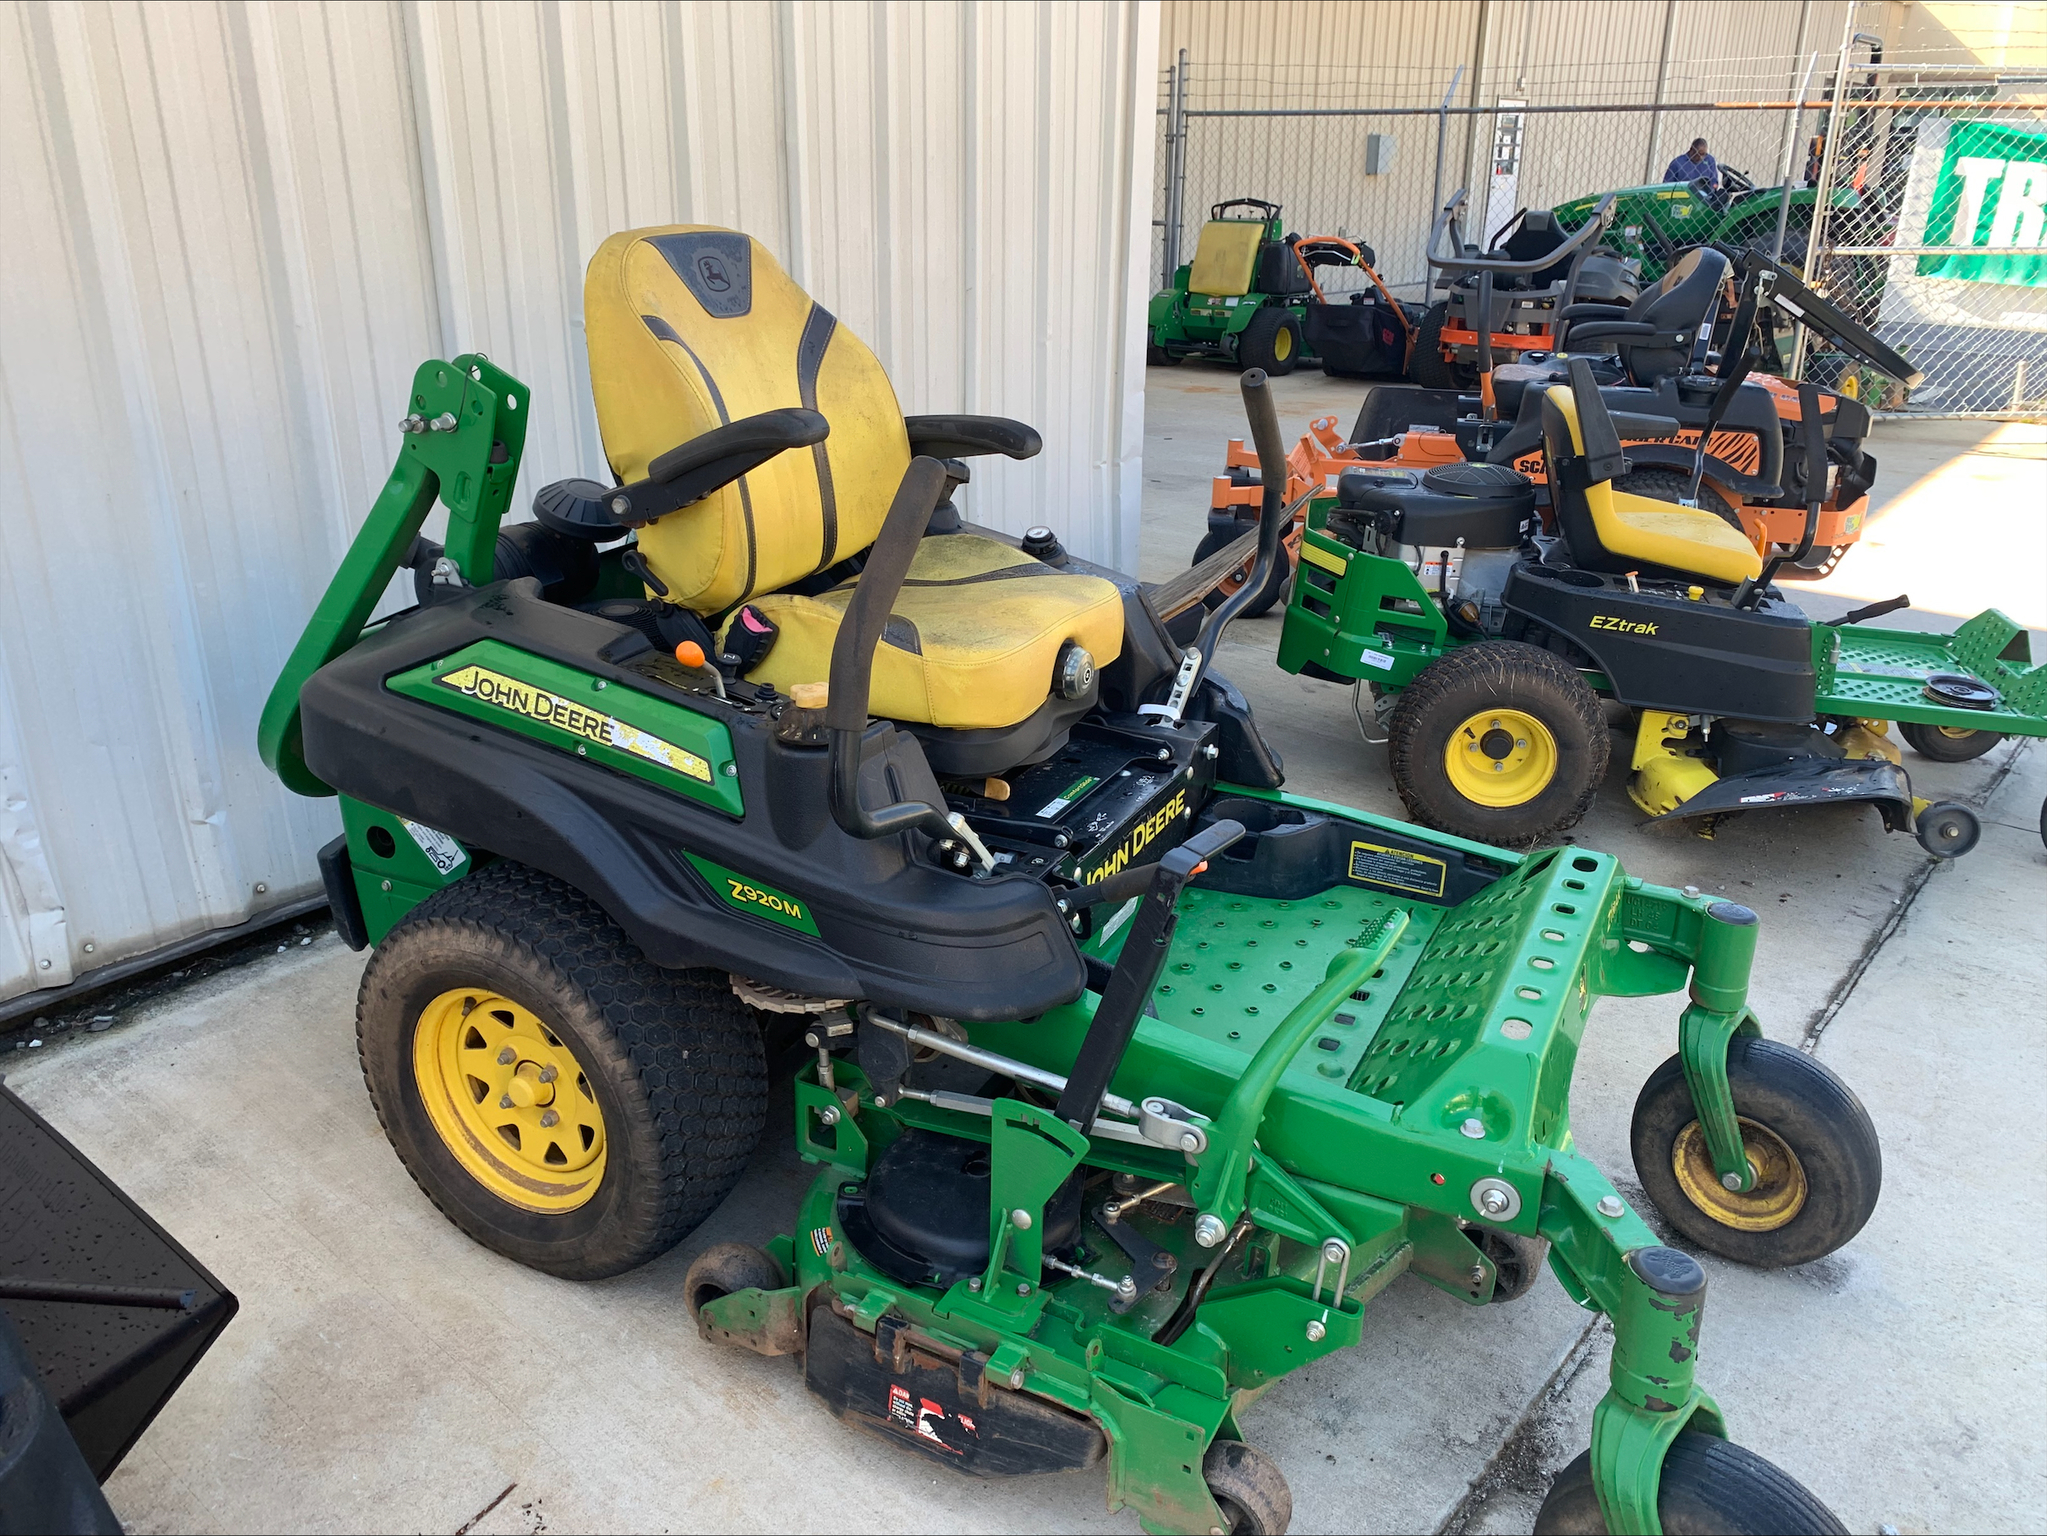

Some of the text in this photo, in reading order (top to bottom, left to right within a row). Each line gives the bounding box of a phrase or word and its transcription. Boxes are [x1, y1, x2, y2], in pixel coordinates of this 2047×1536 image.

[1589, 615, 1660, 635] EZtrak
[464, 670, 615, 743] JOHN DEERE
[1132, 788, 1186, 857] DEERE
[727, 878, 803, 920] Z920M
